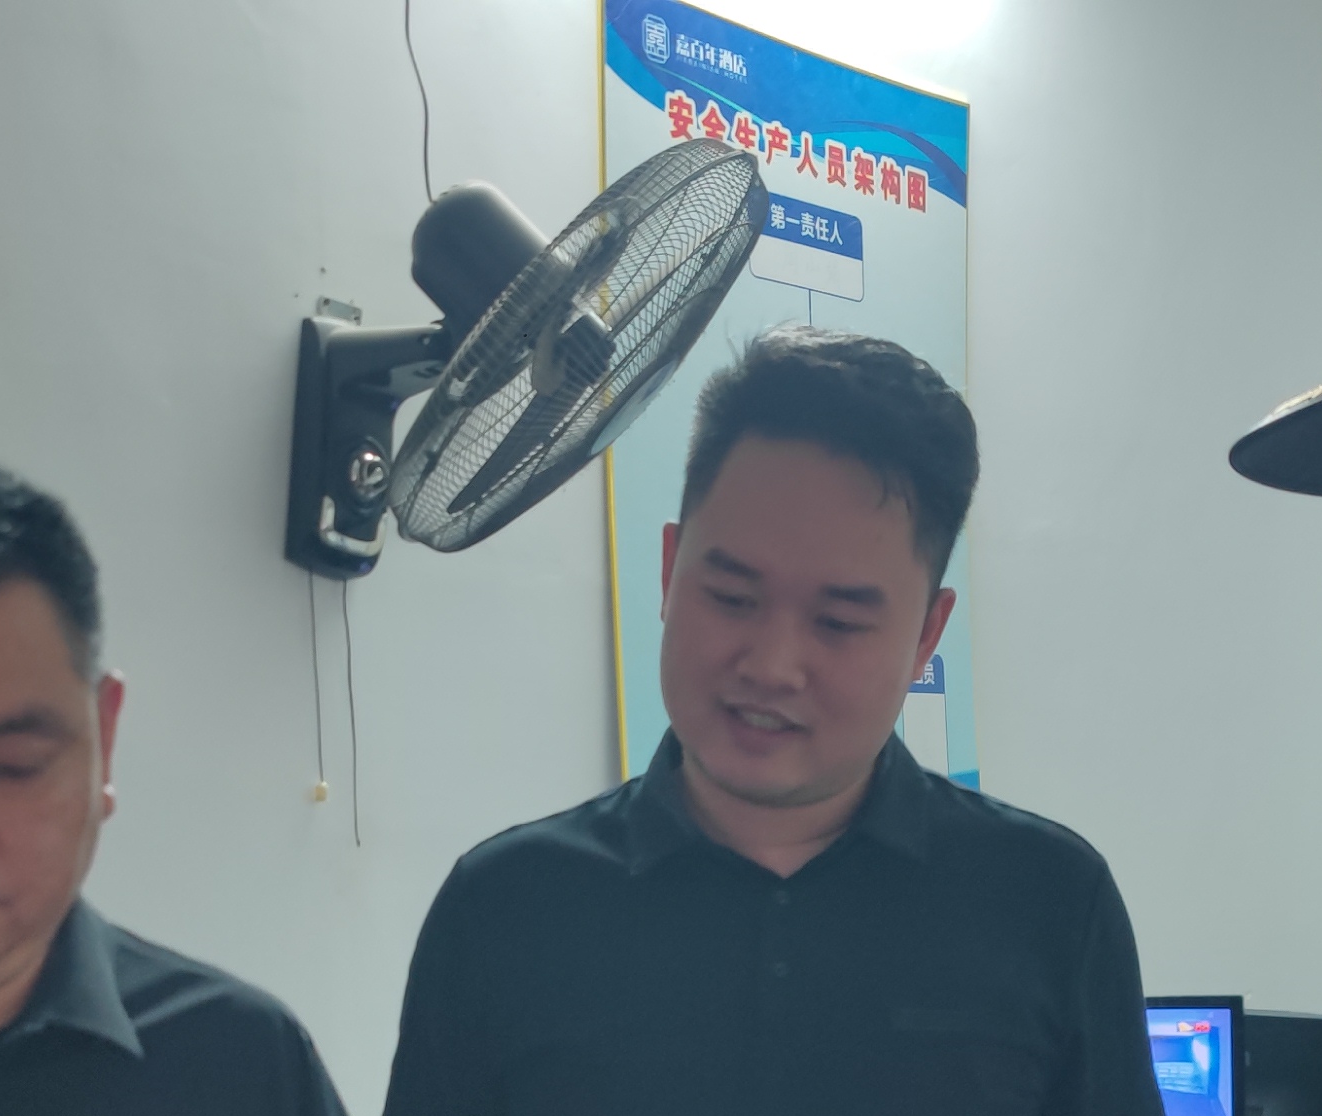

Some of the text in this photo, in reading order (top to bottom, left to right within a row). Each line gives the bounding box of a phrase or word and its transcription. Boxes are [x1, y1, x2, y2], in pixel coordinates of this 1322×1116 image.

[675, 33, 747, 77] 嘉百年酒店
[668, 95, 927, 214] 安全生产人员架构图
[770, 203, 844, 246] 第一责任人
